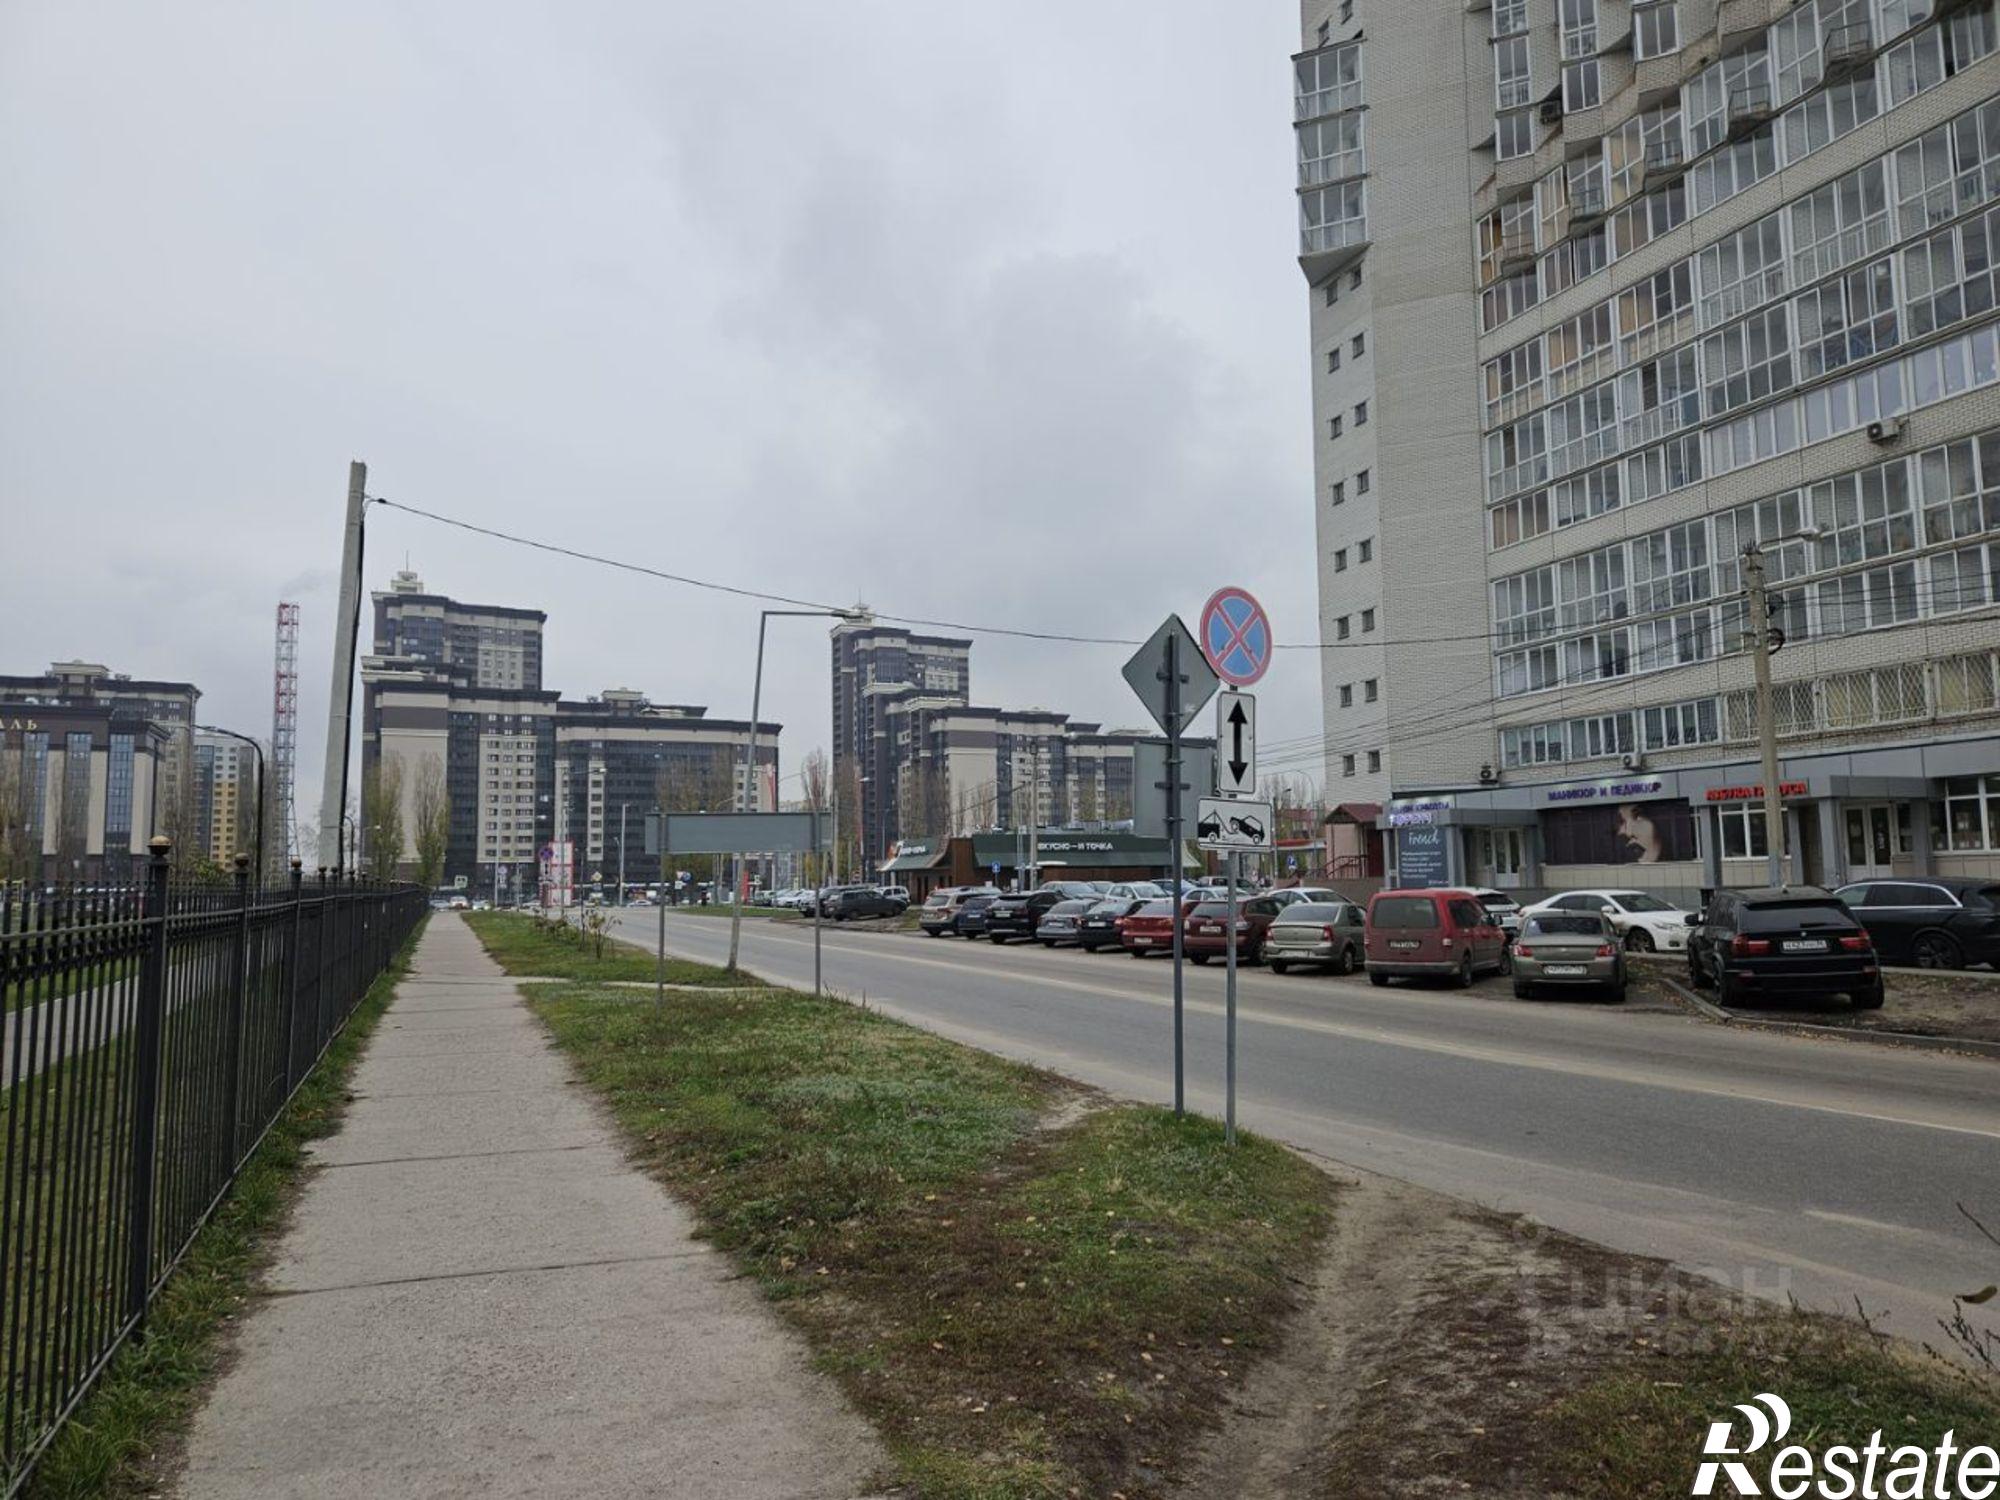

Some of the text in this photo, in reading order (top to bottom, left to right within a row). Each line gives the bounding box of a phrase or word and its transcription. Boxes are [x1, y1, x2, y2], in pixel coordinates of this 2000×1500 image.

[1547, 782, 1662, 801] МАНИКЮР И ПЕДИКЮР
